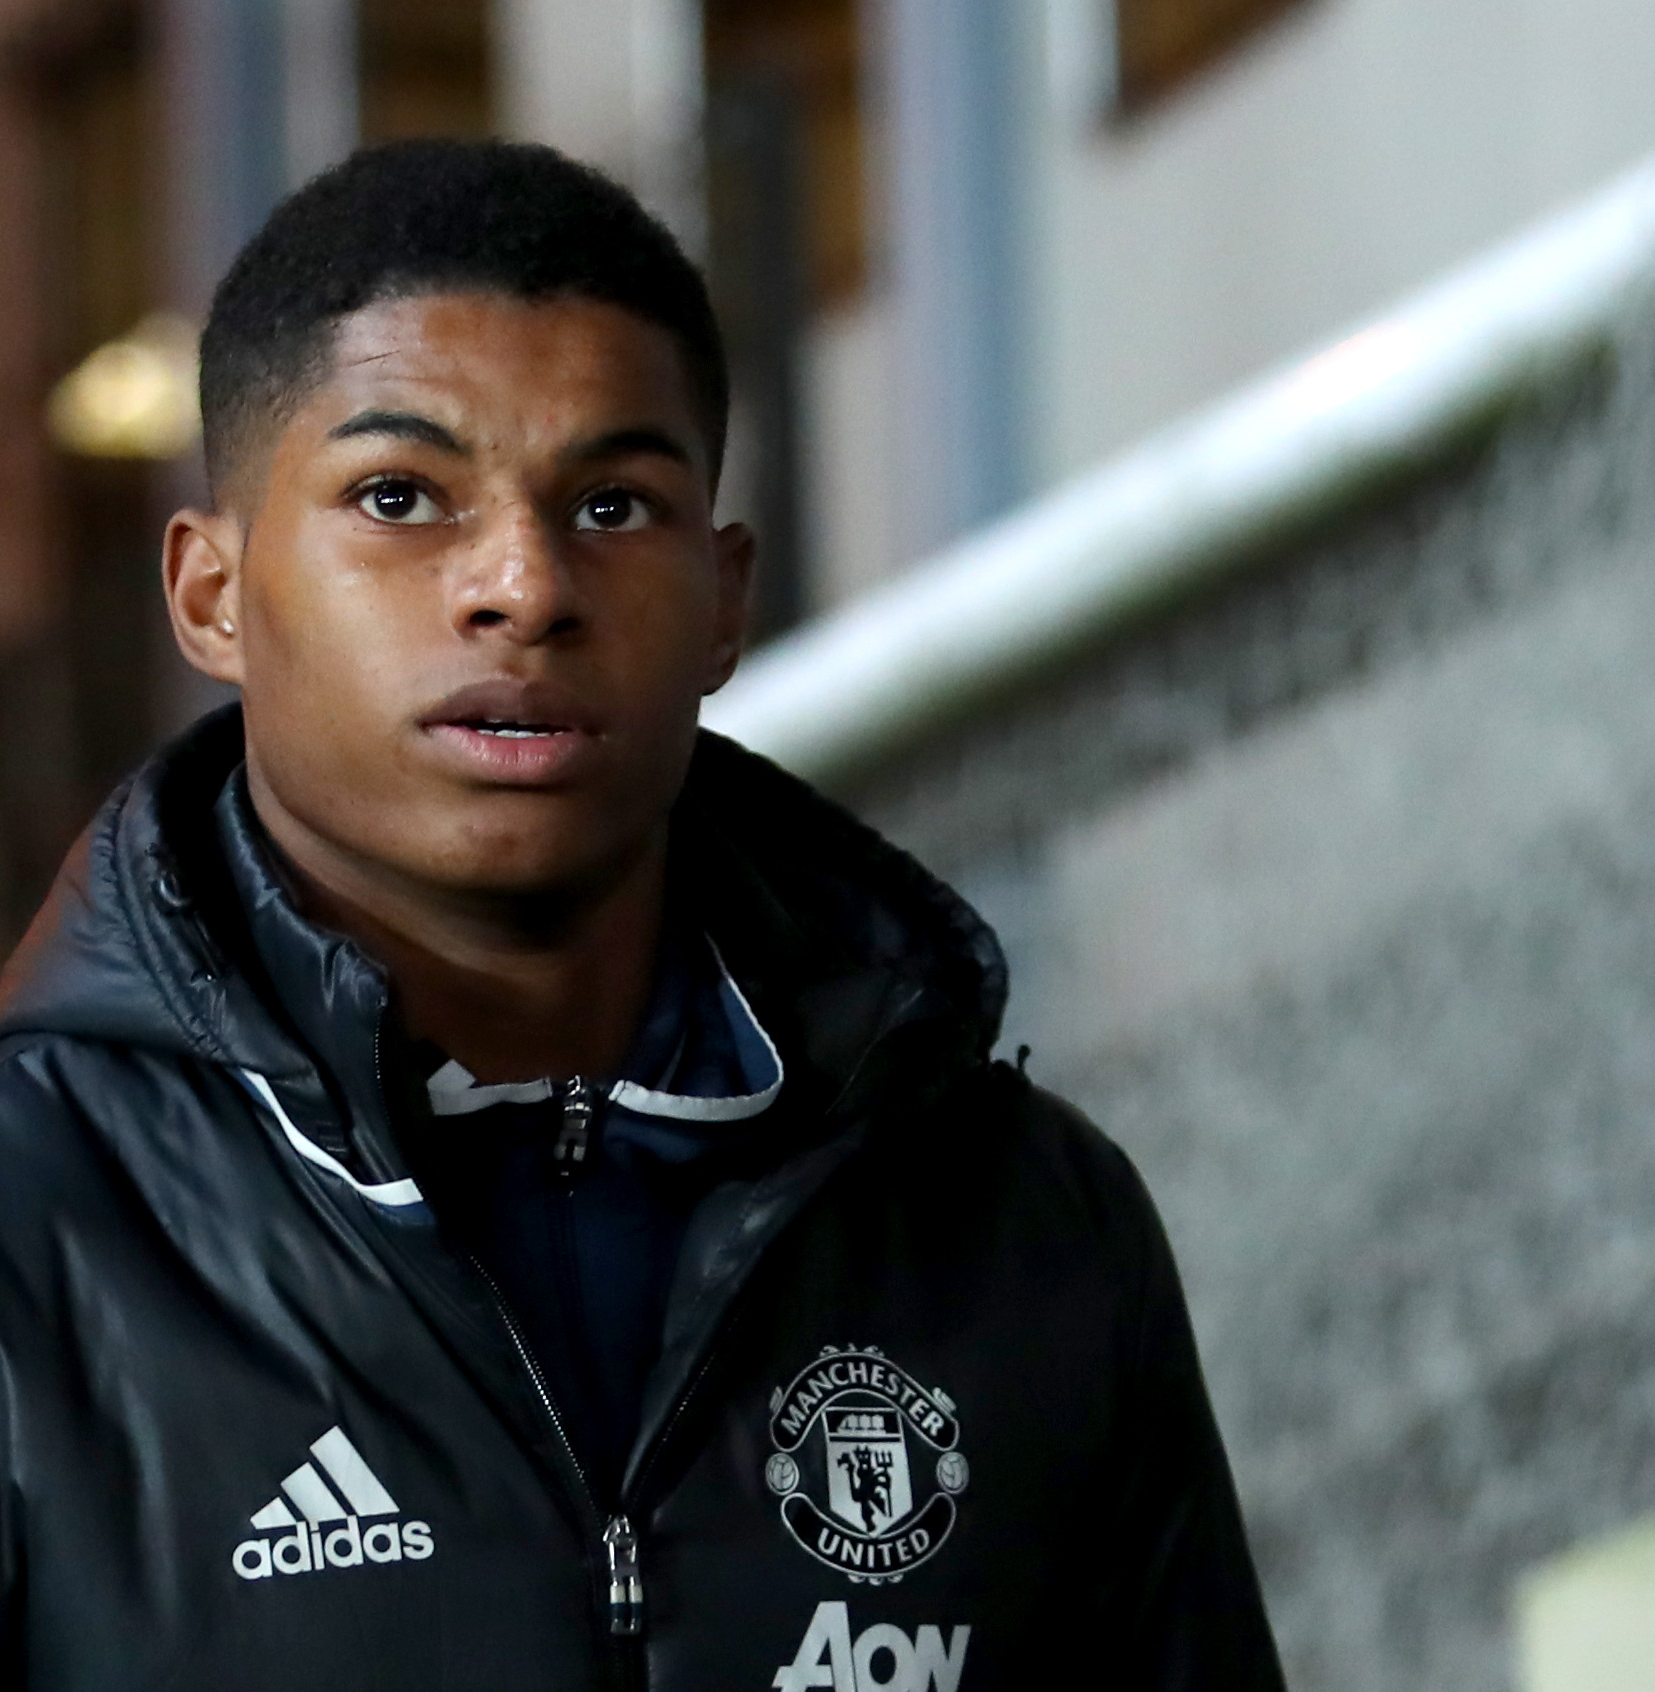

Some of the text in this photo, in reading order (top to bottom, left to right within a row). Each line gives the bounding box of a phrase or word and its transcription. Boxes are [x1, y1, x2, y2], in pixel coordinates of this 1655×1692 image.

[781, 1361, 945, 1436] MANCHESTER
[232, 1514, 435, 1580] adidas
[817, 1527, 930, 1568] UNITED
